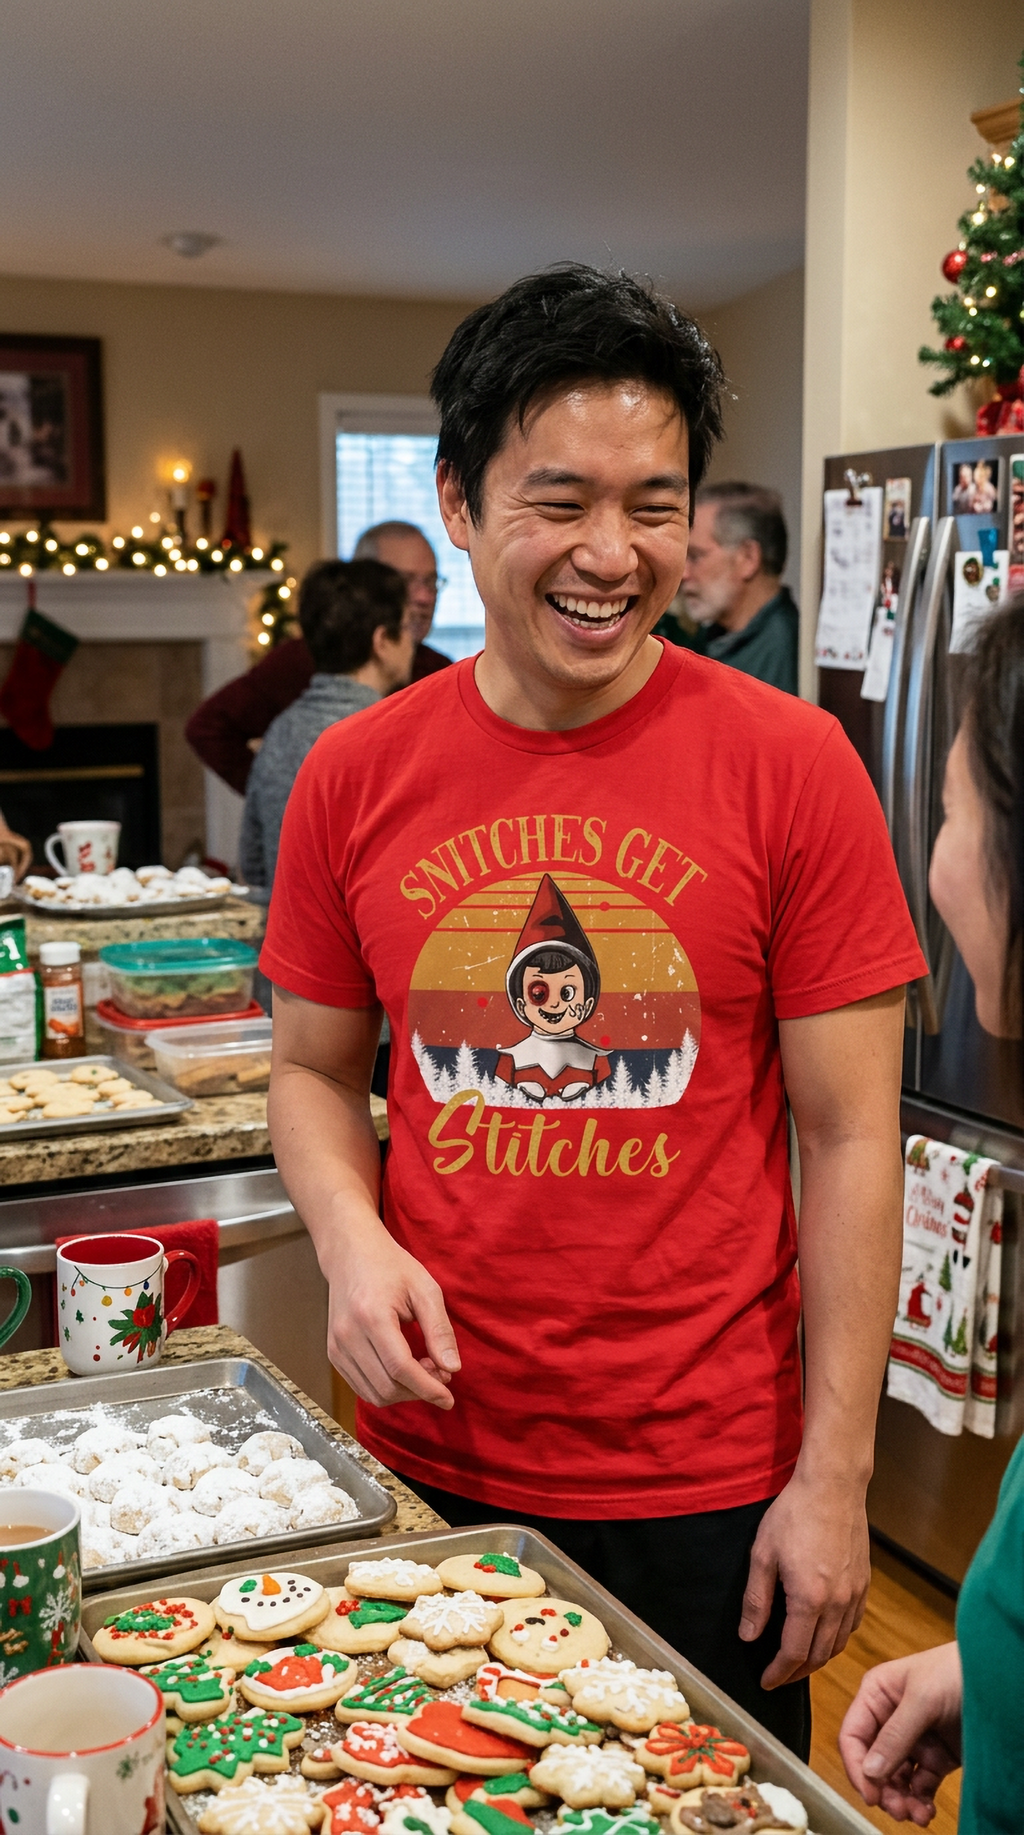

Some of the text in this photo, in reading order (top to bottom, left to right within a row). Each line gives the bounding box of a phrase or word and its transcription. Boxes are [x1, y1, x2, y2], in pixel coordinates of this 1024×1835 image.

[400, 814, 708, 920] SNITCHES GET
[428, 1088, 681, 1178] Stitches
